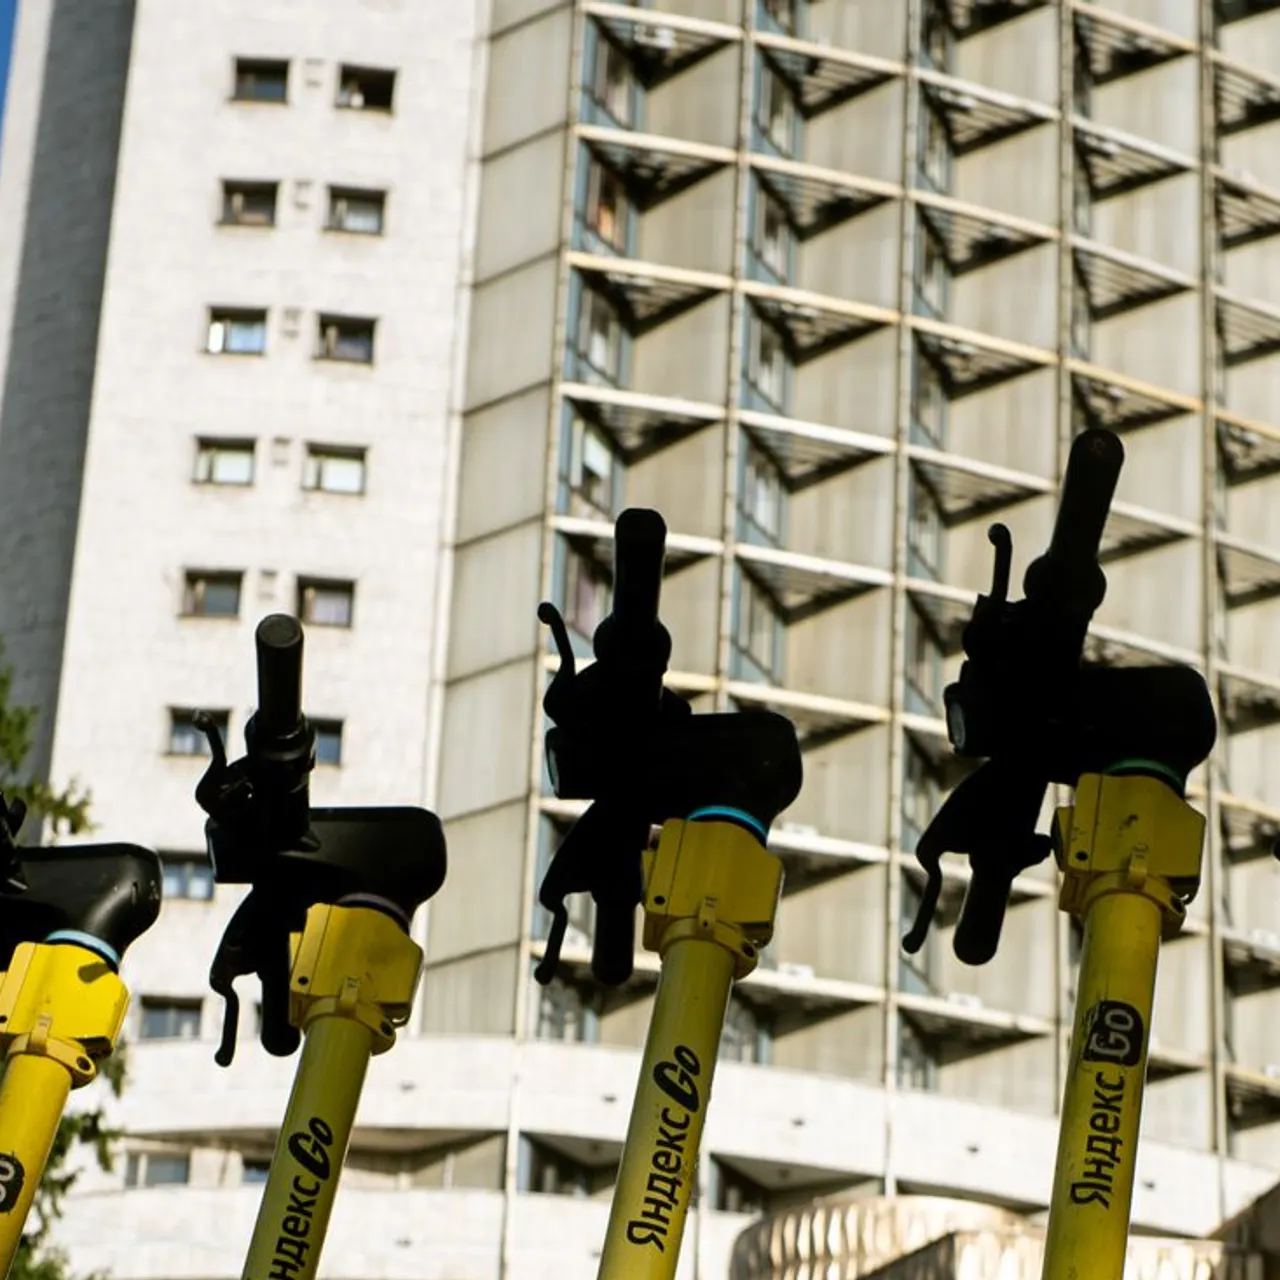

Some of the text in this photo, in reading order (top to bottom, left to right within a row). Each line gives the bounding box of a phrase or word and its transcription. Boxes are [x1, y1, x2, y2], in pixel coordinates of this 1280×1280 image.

[289, 1117, 332, 1179] Go
[627, 1045, 701, 1252] Яндекс Go
[1070, 1008, 1134, 1209] Яндекс Go
